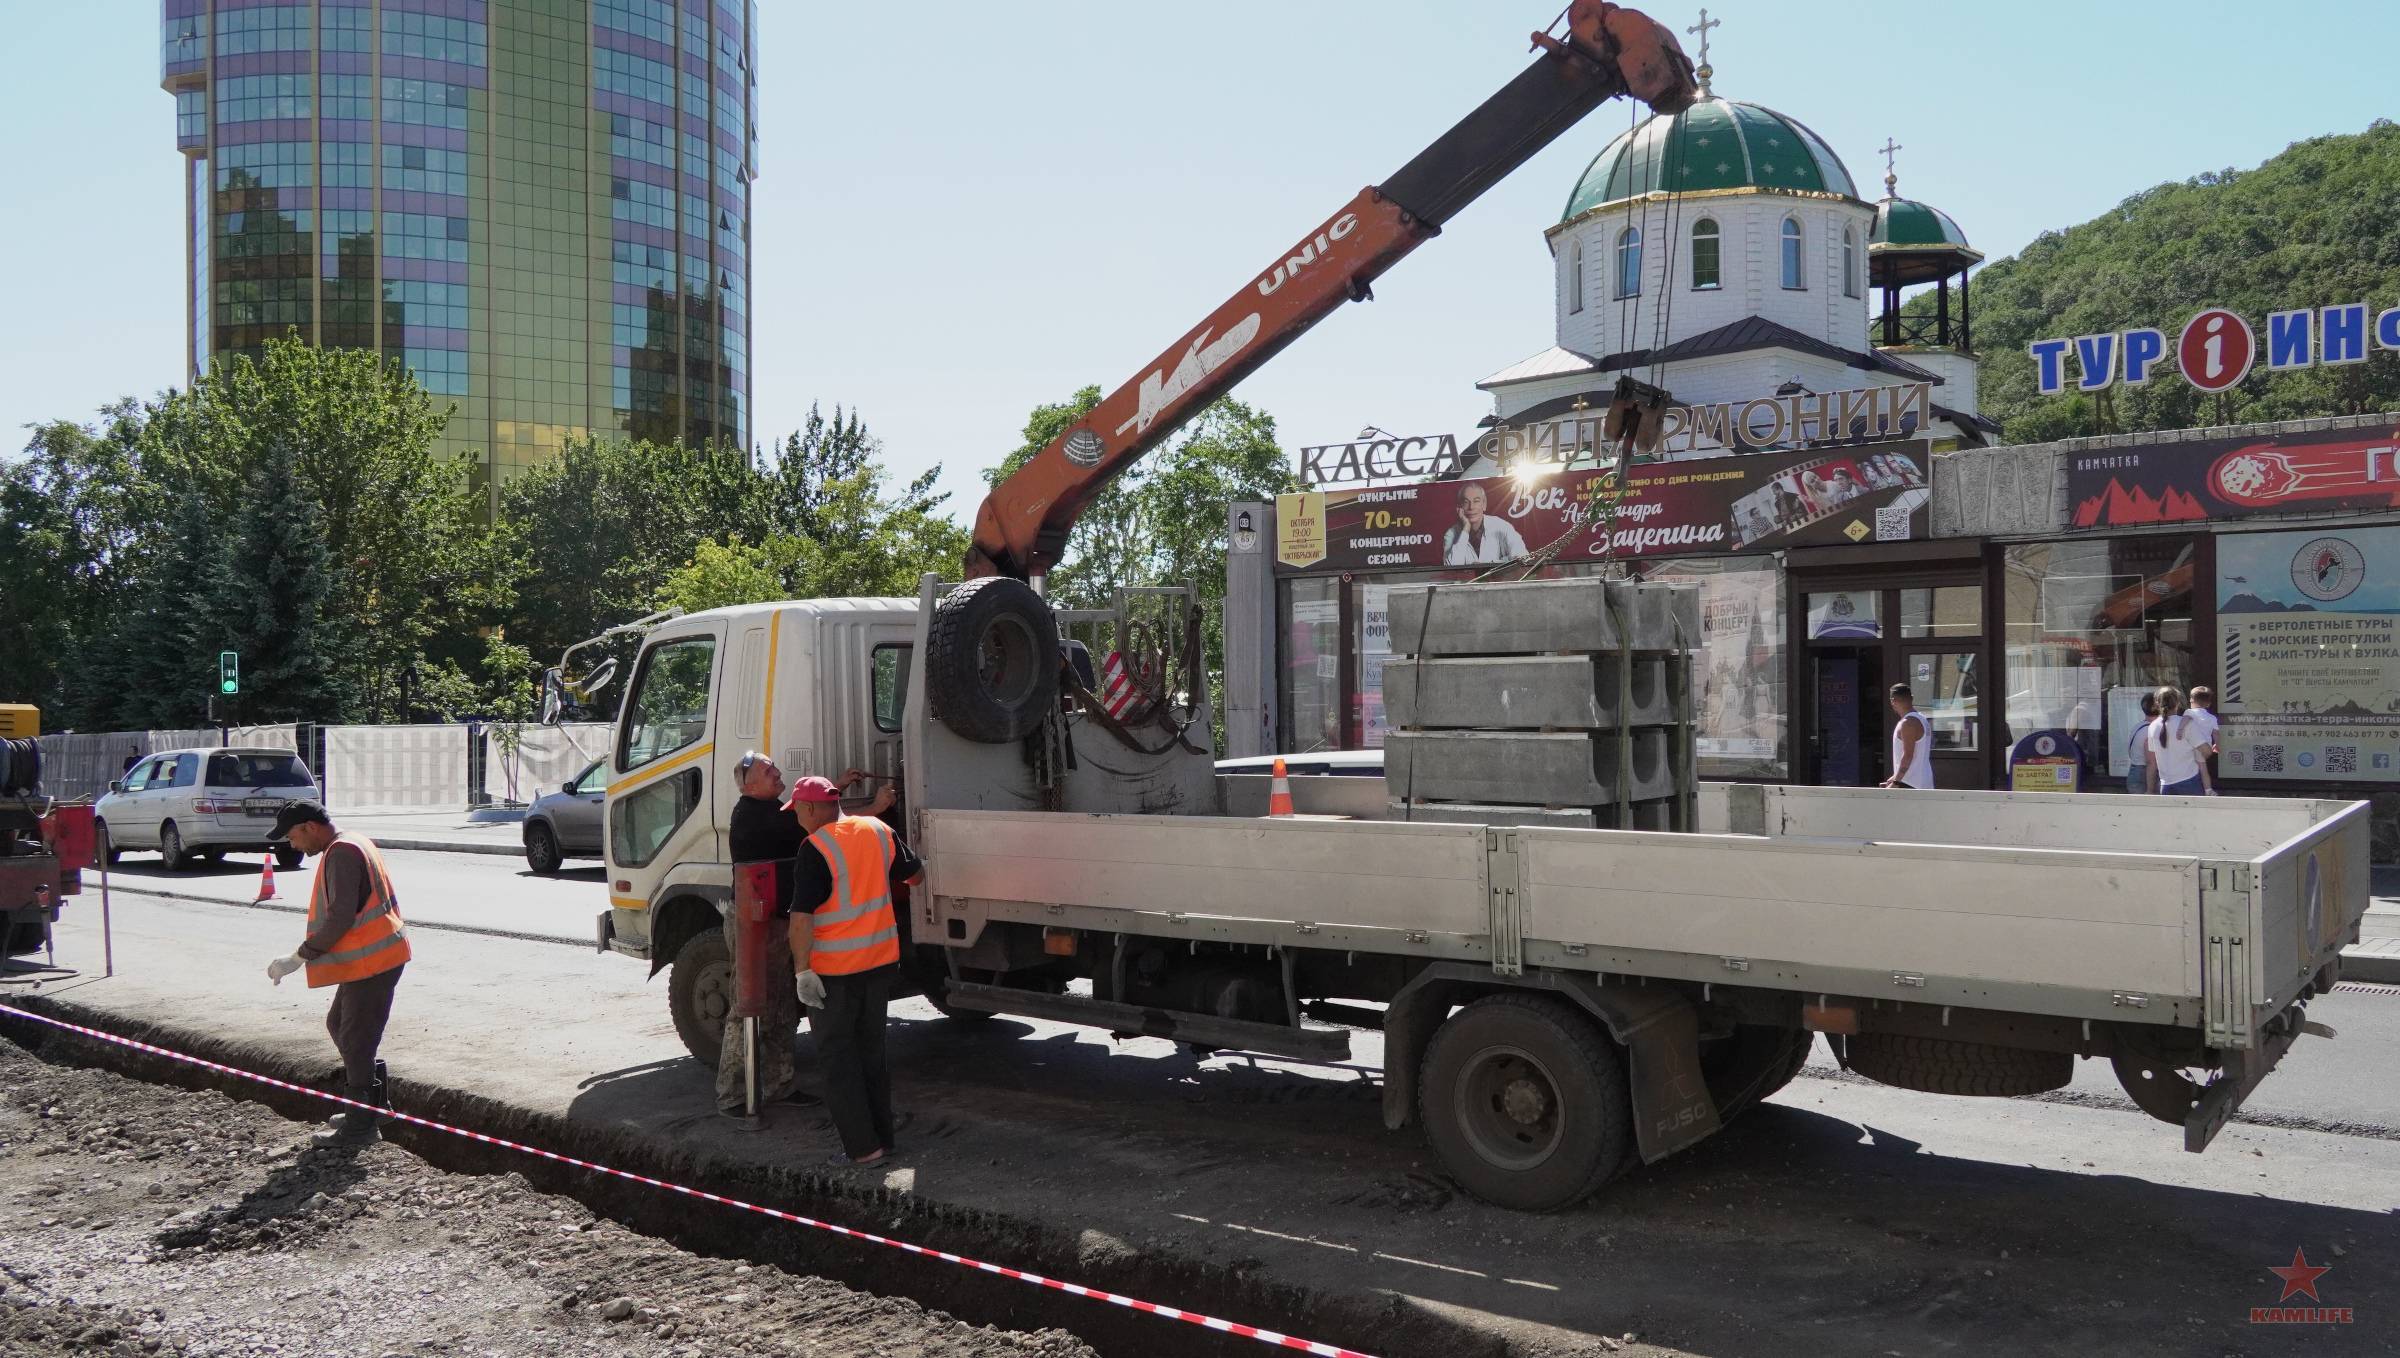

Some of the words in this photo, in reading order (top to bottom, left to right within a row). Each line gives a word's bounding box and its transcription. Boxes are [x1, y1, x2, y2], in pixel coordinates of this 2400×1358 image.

[1258, 213, 1358, 296] UNIC
[2030, 328, 2167, 394] ТУР
[1300, 433, 1464, 484] КАССА
[1477, 381, 1933, 469] ФИЛРМОНИИ
[2077, 455, 2139, 471] КАМЧАТКА
[1669, 474, 1688, 485] ДНЯ
[1691, 471, 1745, 483] РОЖДЕНИЯ
[1357, 488, 1418, 503] ОТКРЫТИЕ
[1298, 495, 1305, 516] 1
[1350, 534, 1432, 549] КОНЦЕРТНОГО
[1588, 520, 1725, 555] Зацепина
[1367, 552, 1411, 565] СЕЗОНА
[1704, 602, 1749, 619] ДОБРЫЙ
[1704, 616, 1748, 632] КОНЦЕРТ
[2259, 620, 2353, 631] ВЕРТОЛЕТНЫЕ
[2356, 619, 2393, 629] ТУРЫ
[2259, 635, 2318, 645] МОРСКИЕ
[2321, 634, 2391, 644] ПРОГУЛКИ
[2258, 649, 2340, 661] ДЖИП-ТУРЫ
[2343, 649, 2351, 658] К
[1656, 1102, 1707, 1138] FUSO
